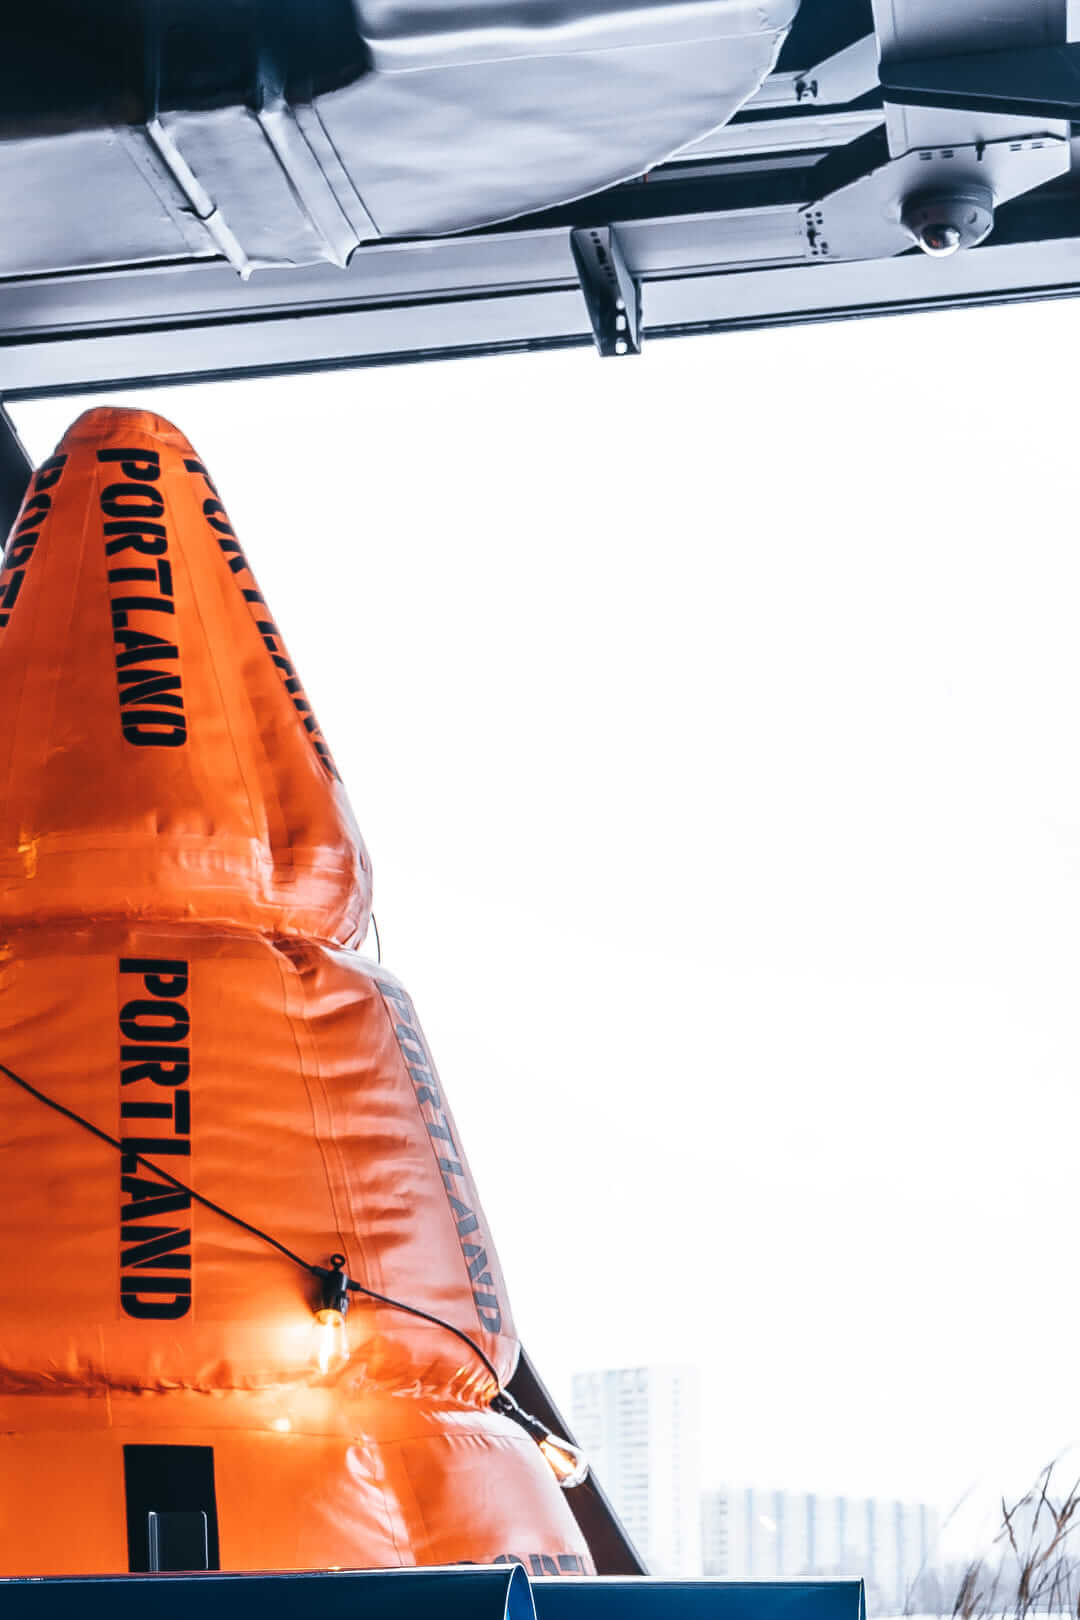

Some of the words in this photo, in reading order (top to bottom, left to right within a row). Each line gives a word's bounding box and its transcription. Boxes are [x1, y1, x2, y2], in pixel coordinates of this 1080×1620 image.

[97, 448, 188, 747] PORTLAND
[183, 458, 344, 784] POLAD
[119, 958, 191, 1320] PORTLAND
[379, 982, 502, 1335] PORTLAND
